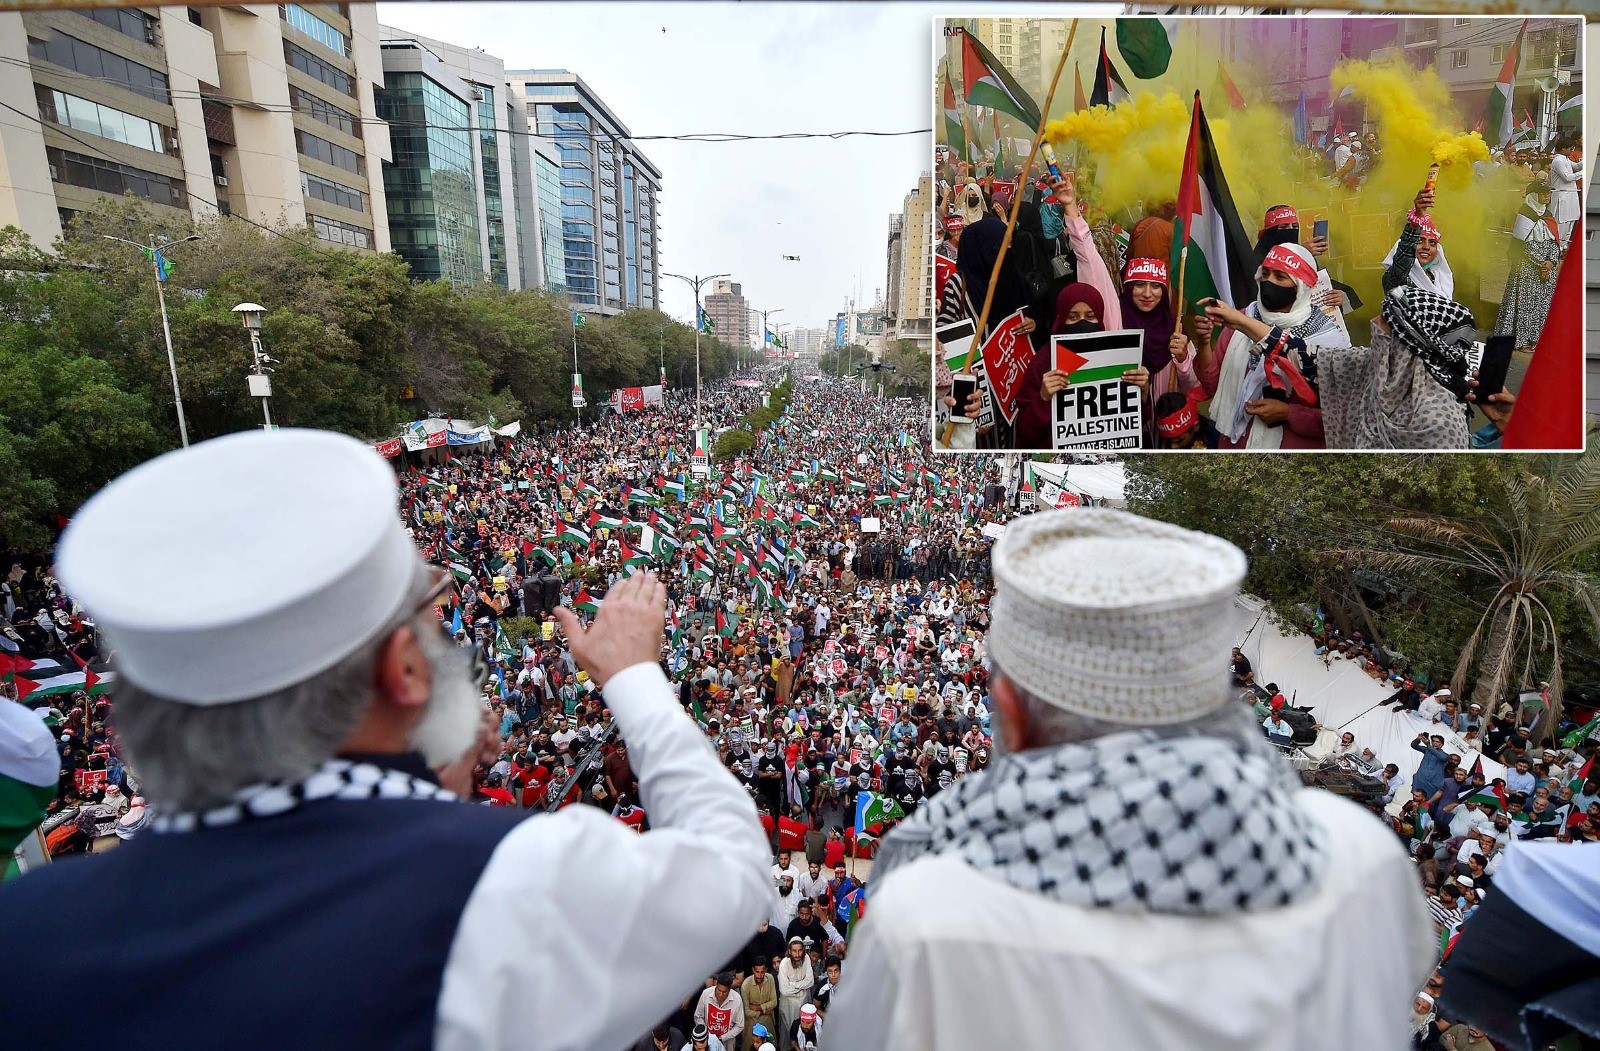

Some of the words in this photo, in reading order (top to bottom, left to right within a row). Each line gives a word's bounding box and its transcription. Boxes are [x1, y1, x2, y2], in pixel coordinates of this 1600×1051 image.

[1056, 381, 1138, 422] FREE
[1056, 416, 1139, 439] PALESTINE
[1020, 492, 1034, 500] FREE
